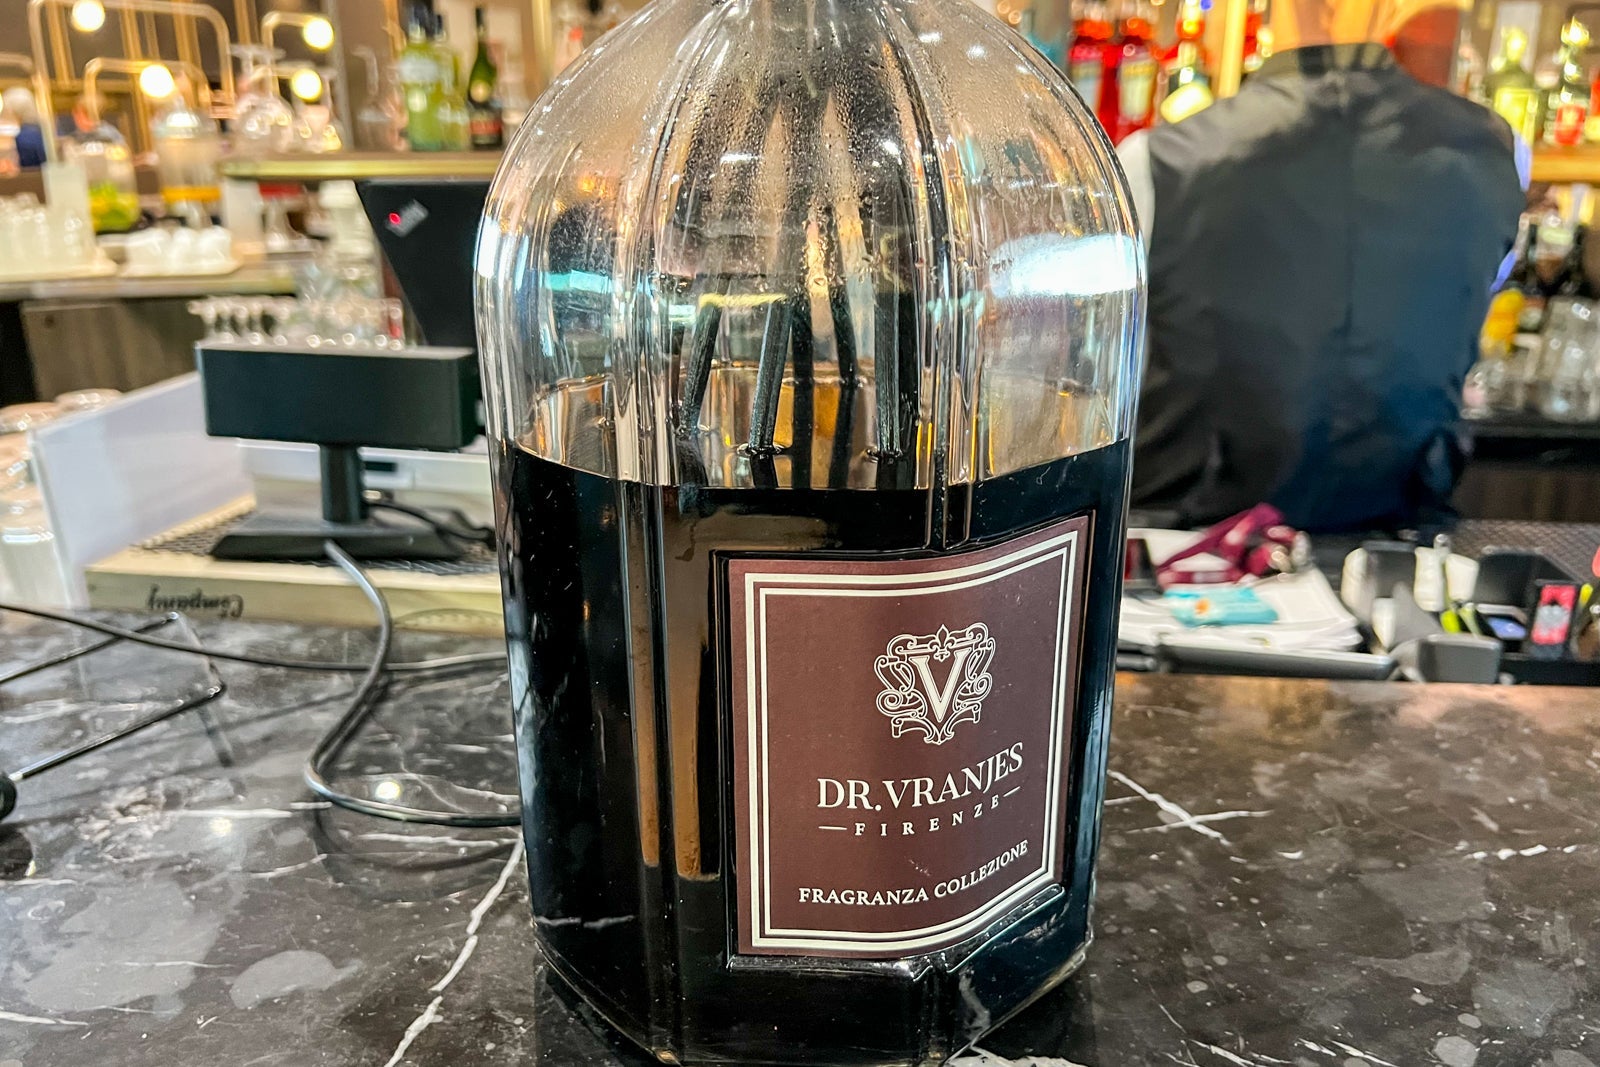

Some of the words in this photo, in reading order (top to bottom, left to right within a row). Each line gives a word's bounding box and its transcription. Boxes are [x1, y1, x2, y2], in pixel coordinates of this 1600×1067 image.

[854, 794, 1000, 837] FIRENZE
[798, 887, 930, 907] FRAGRANZA
[933, 839, 1029, 899] COLLEZIONE
